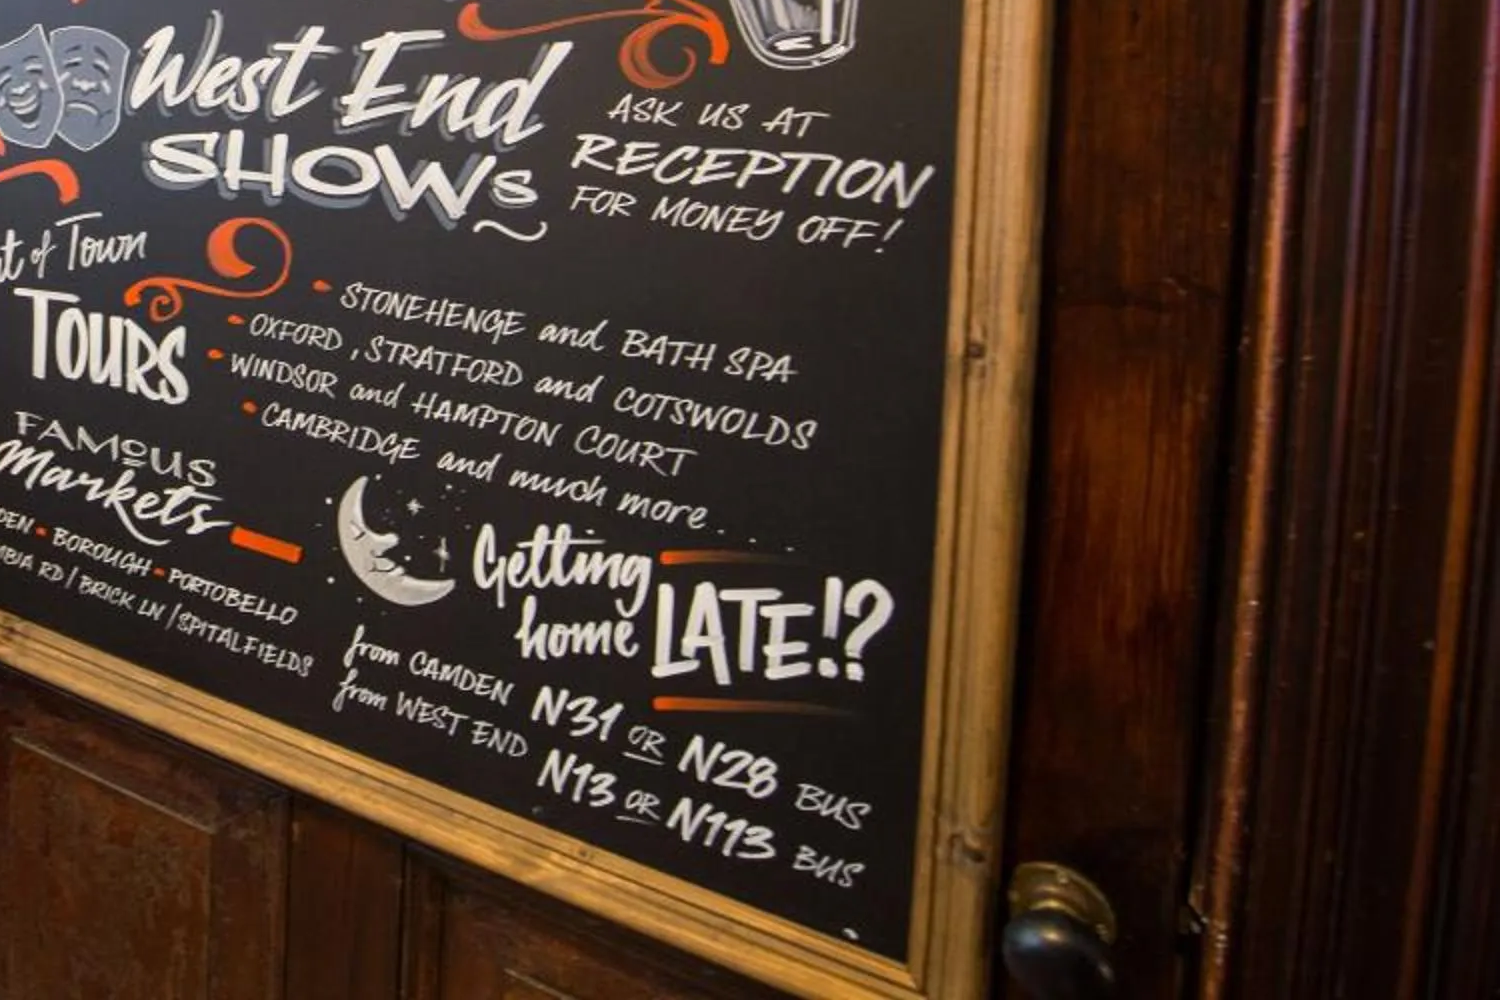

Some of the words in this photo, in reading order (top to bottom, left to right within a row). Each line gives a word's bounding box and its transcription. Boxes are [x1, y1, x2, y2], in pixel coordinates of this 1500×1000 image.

[129, 9, 342, 118] West
[340, 29, 574, 145] End
[606, 92, 682, 127] ASK
[698, 103, 750, 131] US
[762, 106, 832, 138] AT
[569, 185, 637, 217] FOR
[651, 196, 785, 241] MONEY
[796, 215, 904, 255] OFF!
[570, 132, 936, 210] RECEPTION
[30, 229, 57, 279] of
[54, 211, 148, 271] Town
[13, 287, 191, 405] TOURS
[339, 281, 527, 344] STONEHENGE
[537, 319, 609, 352] and
[621, 328, 717, 371] BATH
[724, 346, 799, 383] SPA
[230, 352, 339, 398] WINDSOR
[349, 381, 407, 408] and
[409, 391, 563, 447] HAMPTON
[574, 425, 699, 477] COURT
[365, 335, 524, 388] STRATFORD
[534, 375, 605, 403] and
[613, 386, 818, 451] COTSWOLDS
[14, 411, 218, 488] FAMOUS
[261, 401, 421, 464] CAMBRIDGE
[436, 451, 503, 482] and
[508, 468, 609, 507] much
[53, 528, 152, 577] BOROUGH
[168, 567, 298, 626] PORTOBELLO
[473, 523, 654, 618] Getting
[78, 575, 135, 609] BRICK
[177, 611, 314, 678] SPITALFIELDS
[343, 625, 400, 667] from
[409, 651, 517, 706] CAMDEN
[515, 595, 642, 662] home
[651, 576, 896, 687] LATE!?
[332, 669, 389, 713] from
[395, 691, 468, 737] WEST
[471, 721, 530, 760] END
[531, 686, 626, 742] N31
[628, 724, 666, 760] OR
[678, 734, 780, 800] N28
[537, 749, 616, 808] N13
[620, 789, 662, 824] OR
[666, 796, 777, 861] N113
